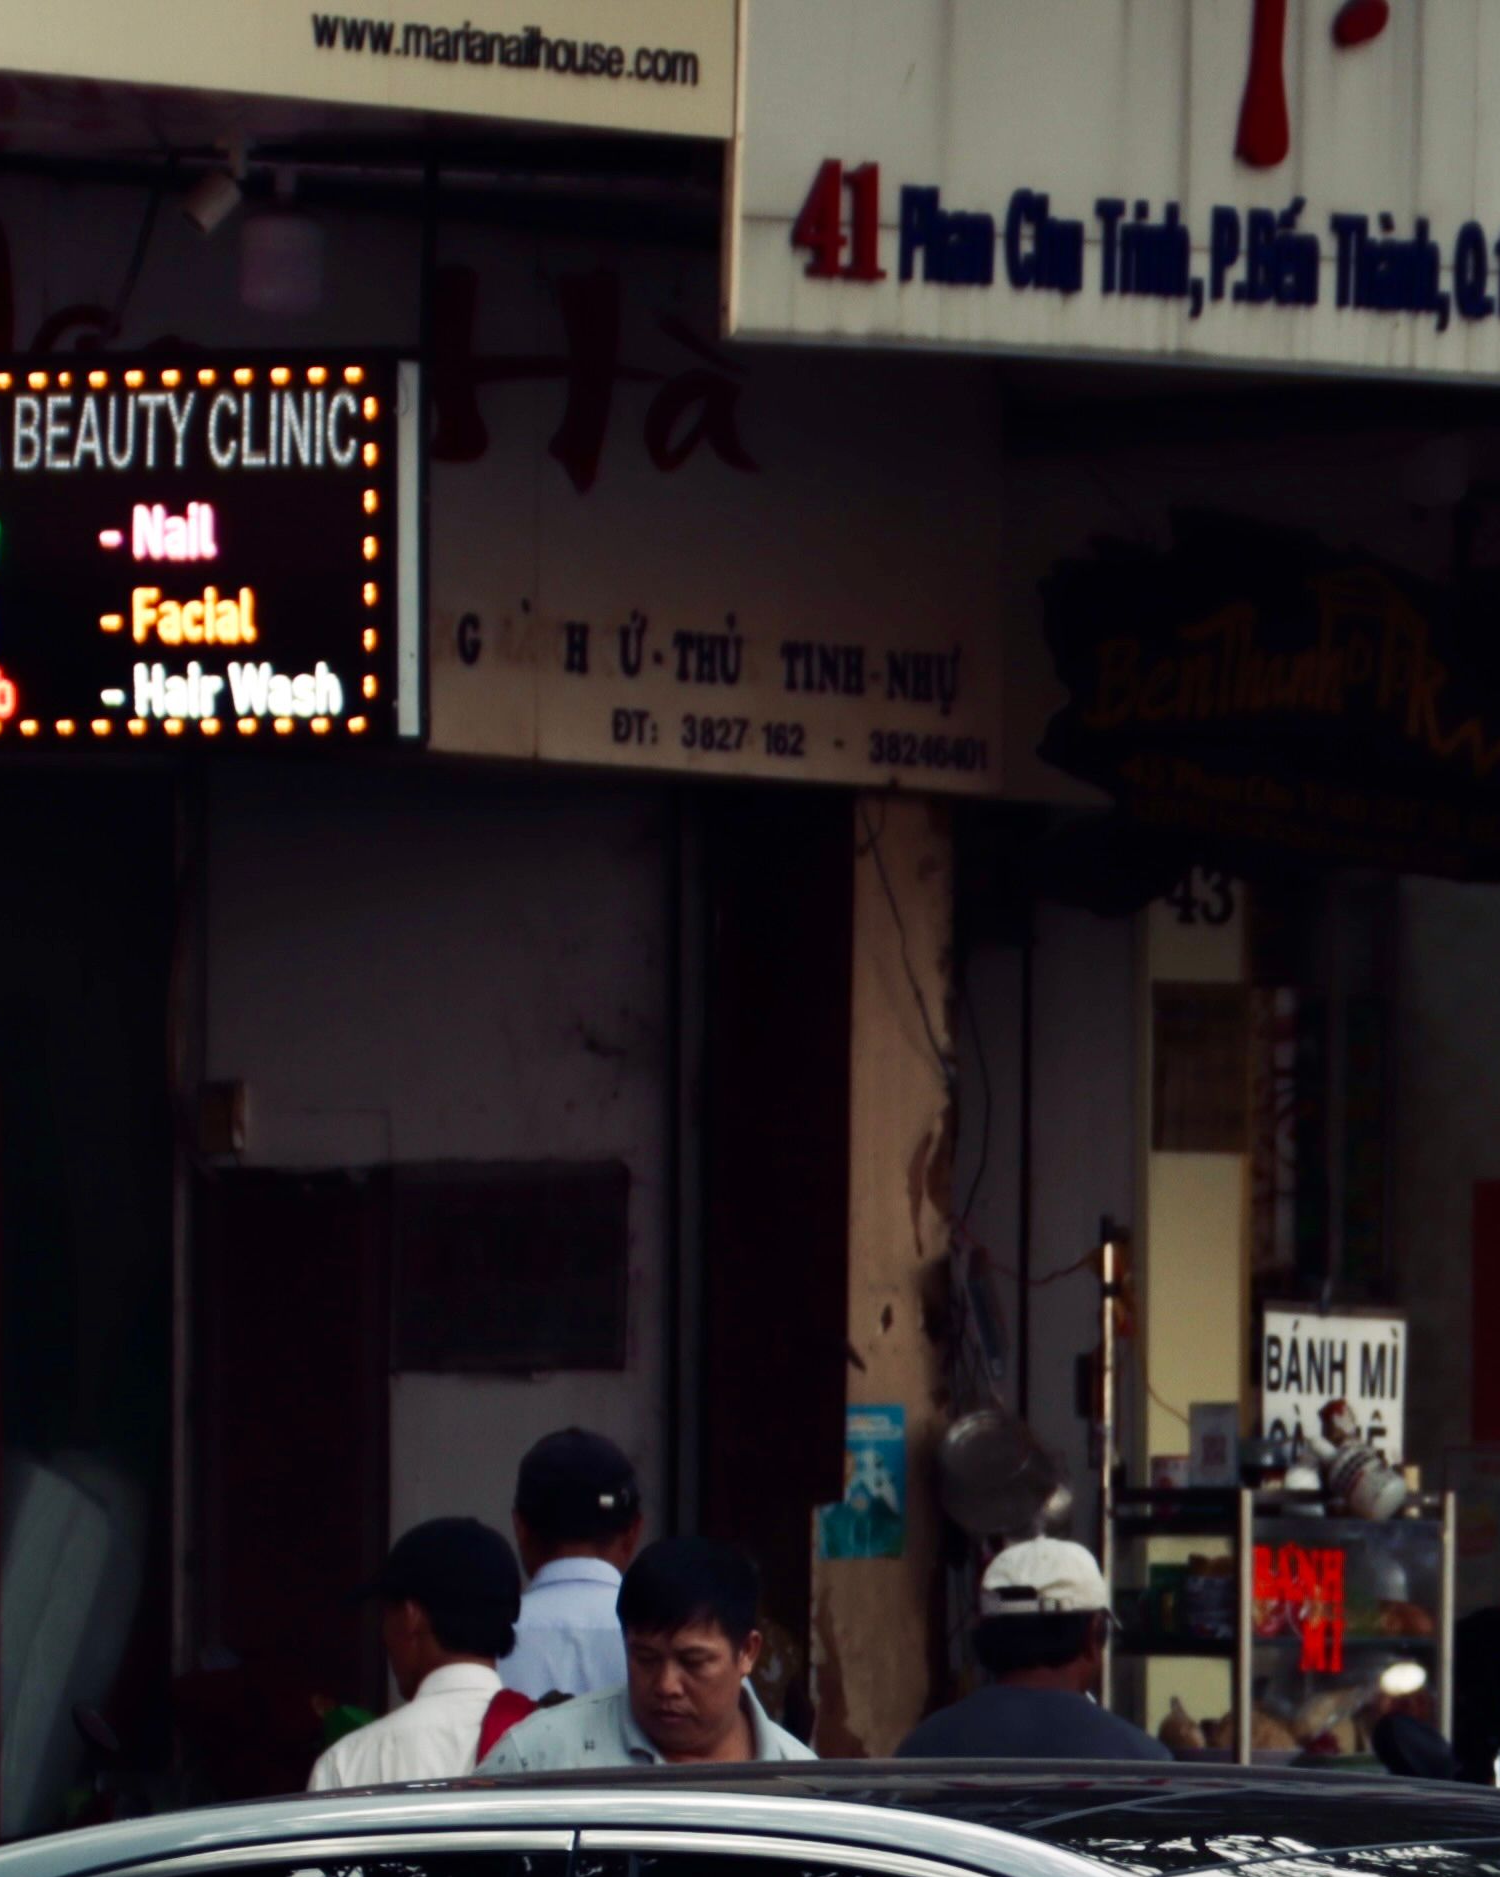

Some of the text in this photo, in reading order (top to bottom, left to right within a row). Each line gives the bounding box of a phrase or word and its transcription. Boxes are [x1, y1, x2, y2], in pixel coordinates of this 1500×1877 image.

[311, 10, 700, 87] www.marianailhouse.com
[790, 157, 887, 283] 41
[898, 183, 994, 286] Phan
[1004, 188, 1085, 293] Chu
[12, 391, 196, 471] BEAUTY
[207, 389, 358, 468] CLINIC
[131, 501, 219, 561] Nail
[131, 586, 258, 645] Facial
[131, 660, 225, 720] Hair
[227, 660, 344, 718] Wash
[1165, 865, 1234, 927] 43
[1265, 1319, 1400, 1401] BÁNH MÌ
